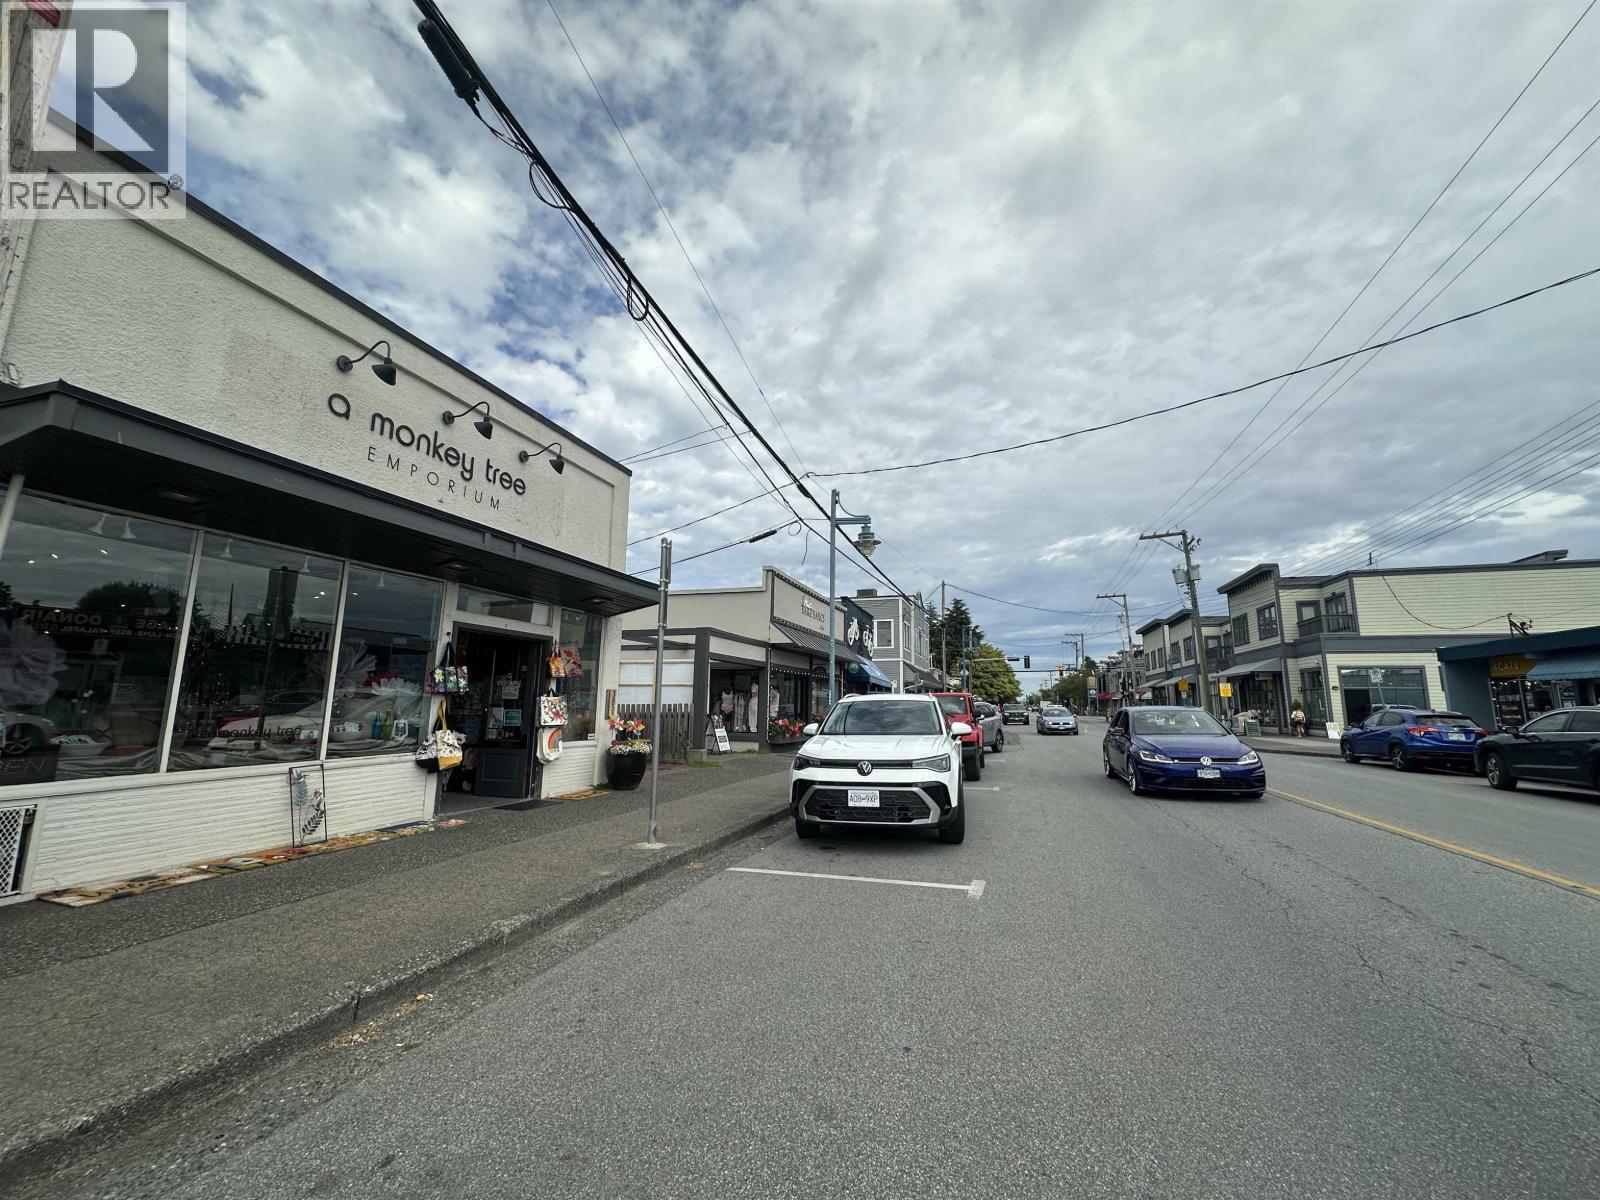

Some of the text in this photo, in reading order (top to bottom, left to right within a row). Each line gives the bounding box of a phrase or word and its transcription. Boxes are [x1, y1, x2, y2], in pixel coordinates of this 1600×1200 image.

[328, 393, 527, 496] a monkey tree
[367, 446, 500, 511] EMPORIUM
[277, 725, 303, 737] tree
